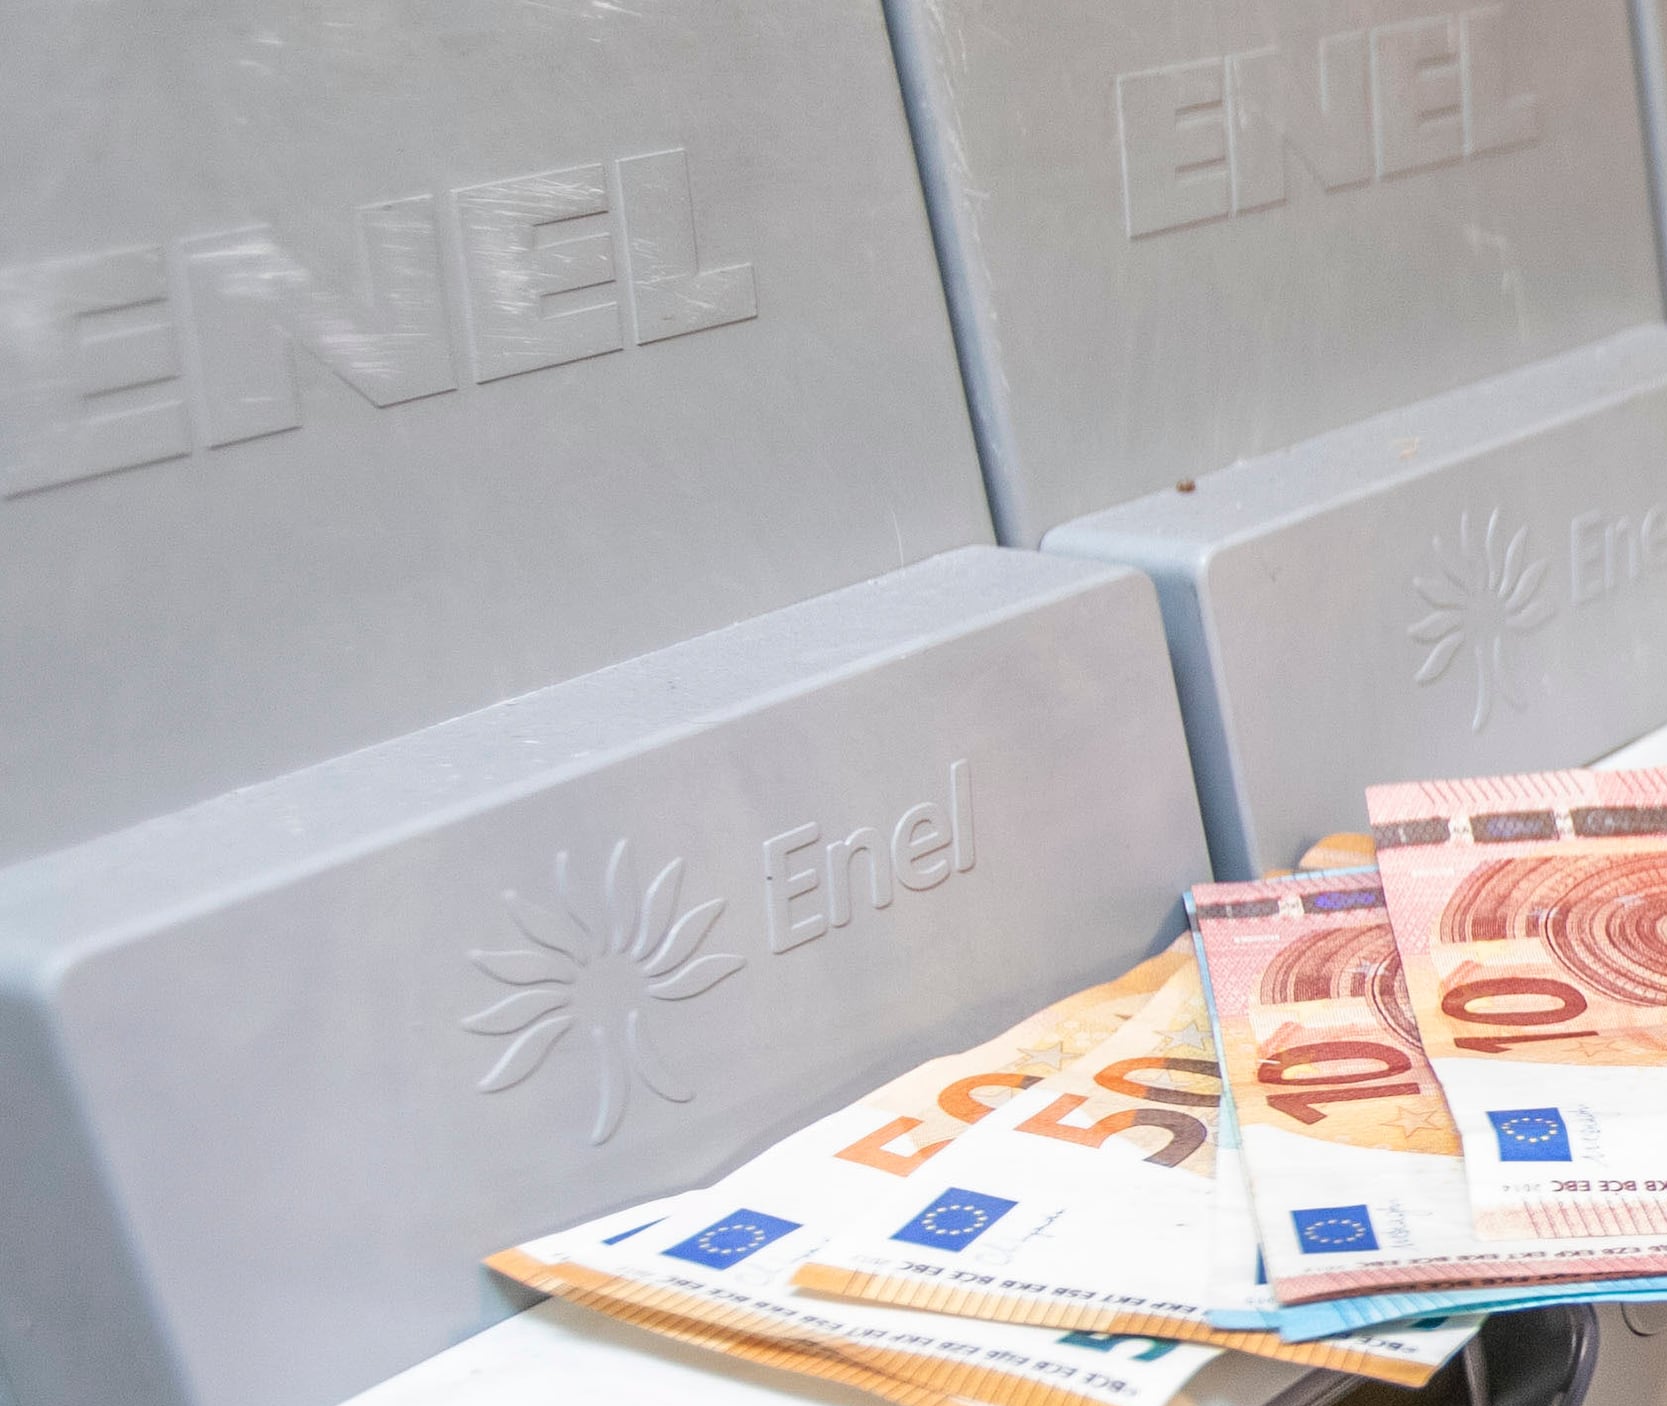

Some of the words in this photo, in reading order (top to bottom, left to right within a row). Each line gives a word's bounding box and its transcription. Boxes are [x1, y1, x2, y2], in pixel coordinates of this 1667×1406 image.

[1113, 6, 1542, 241] ENEL
[0, 147, 758, 502] ENEL
[763, 758, 976, 955] Enel
[1440, 976, 1599, 1053] 10
[1014, 1056, 1224, 1168] 50
[1257, 1040, 1420, 1125] 10
[1551, 1180, 1591, 1192] EBC
